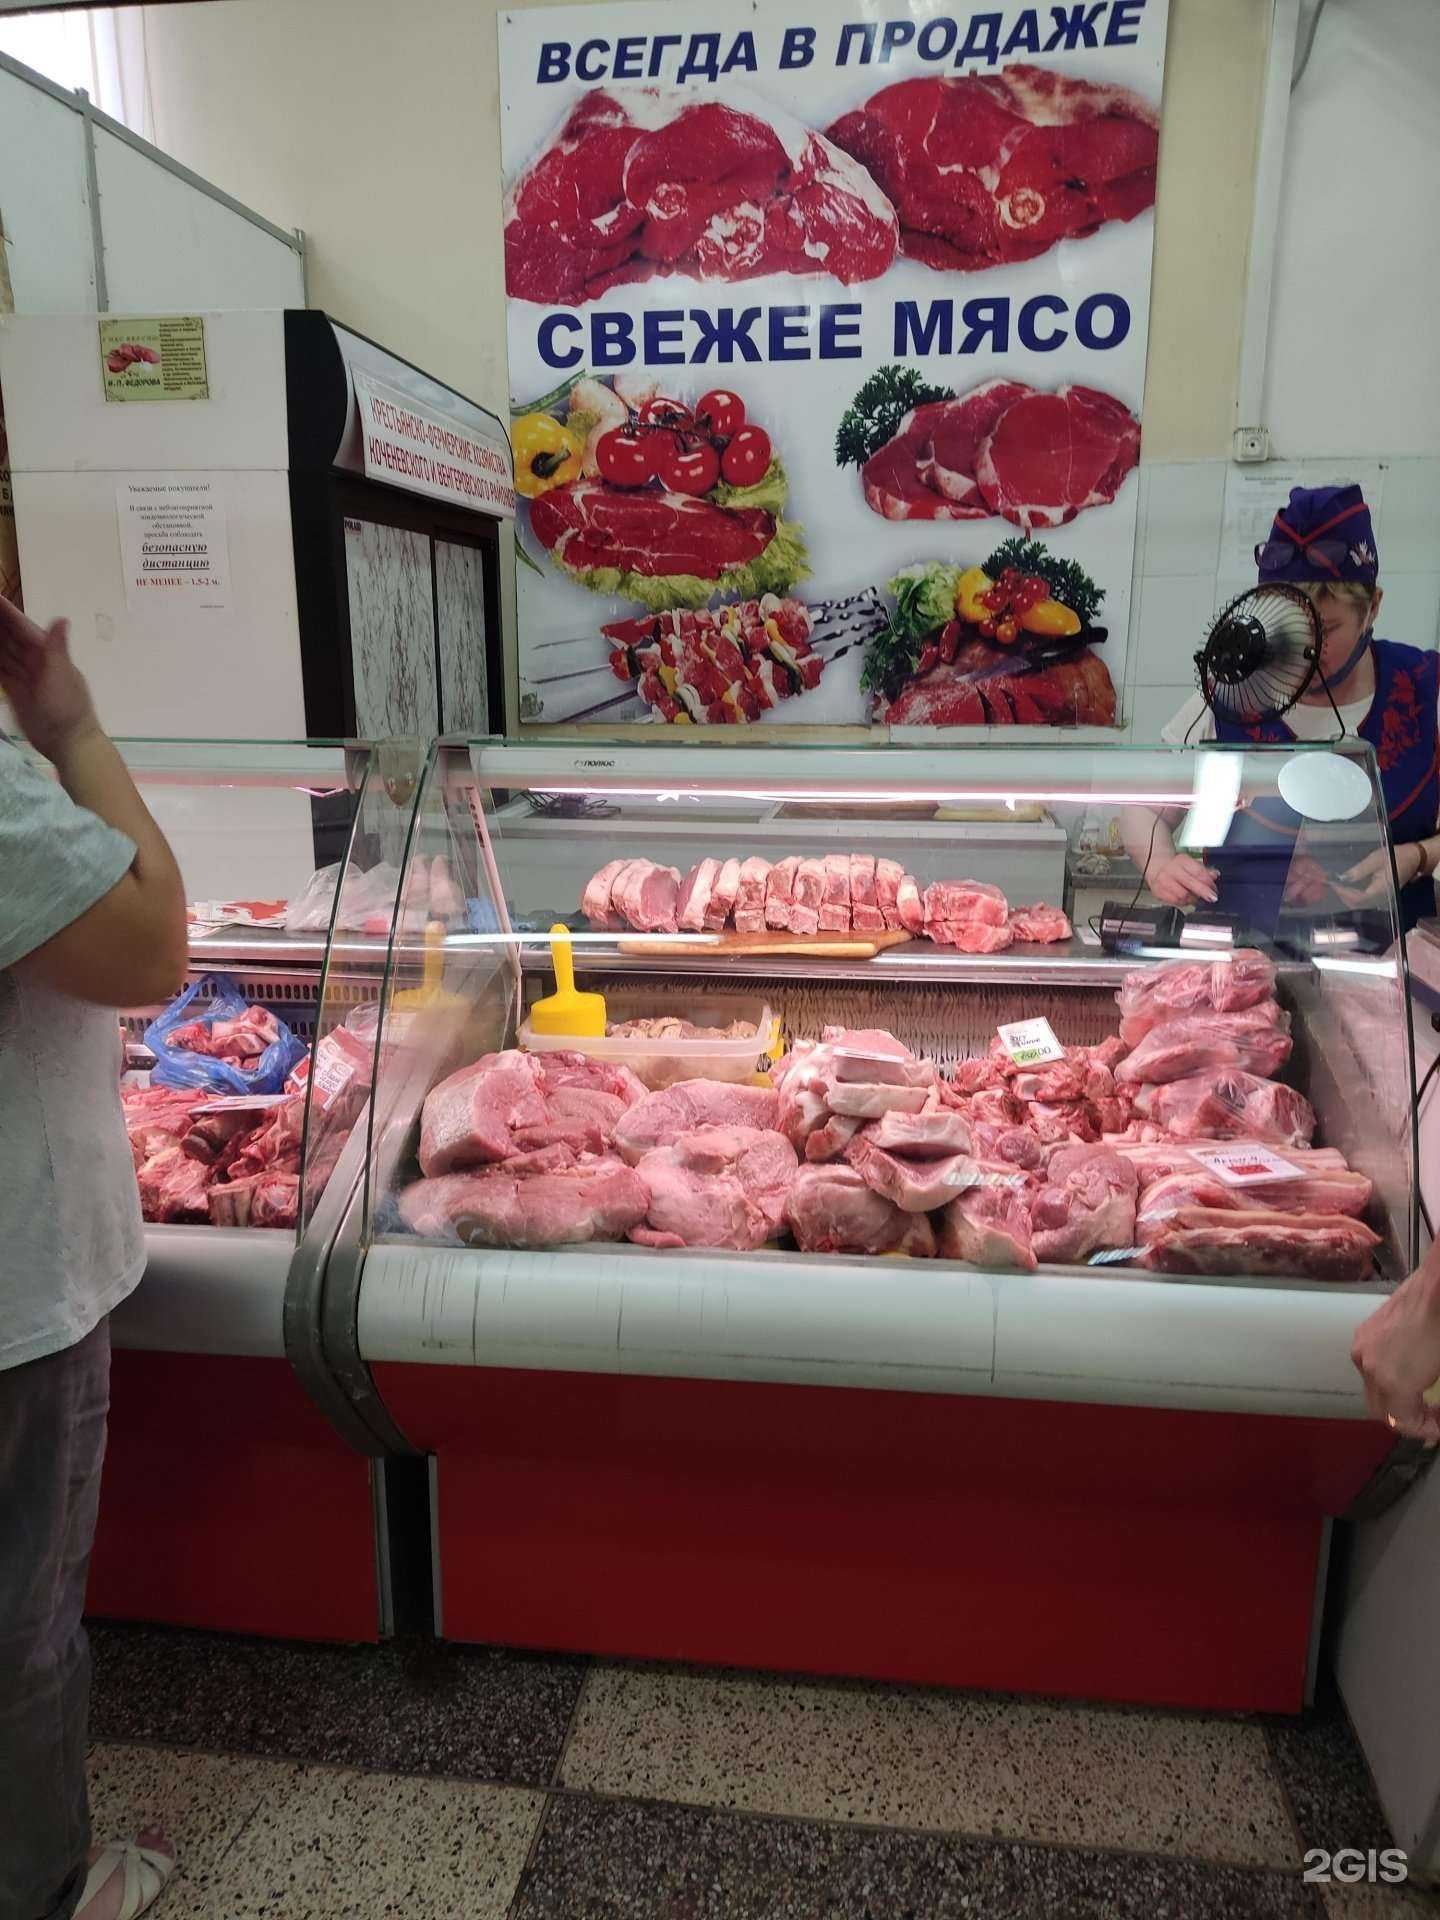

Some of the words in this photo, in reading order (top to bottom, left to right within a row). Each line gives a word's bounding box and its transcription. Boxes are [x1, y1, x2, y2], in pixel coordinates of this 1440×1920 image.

[537, 31, 757, 84] ВСЕГДА
[779, 27, 816, 69] В
[835, 0, 1146, 67] ПРОДАЖЕ
[537, 304, 862, 368] СВЕЖЕЕ
[893, 293, 1130, 356] МЯСО
[142, 542, 208, 554] безопасную
[142, 558, 210, 570] дистанцию
[136, 577, 148, 586] НЕ
[150, 577, 183, 586] МЕНЕЕ
